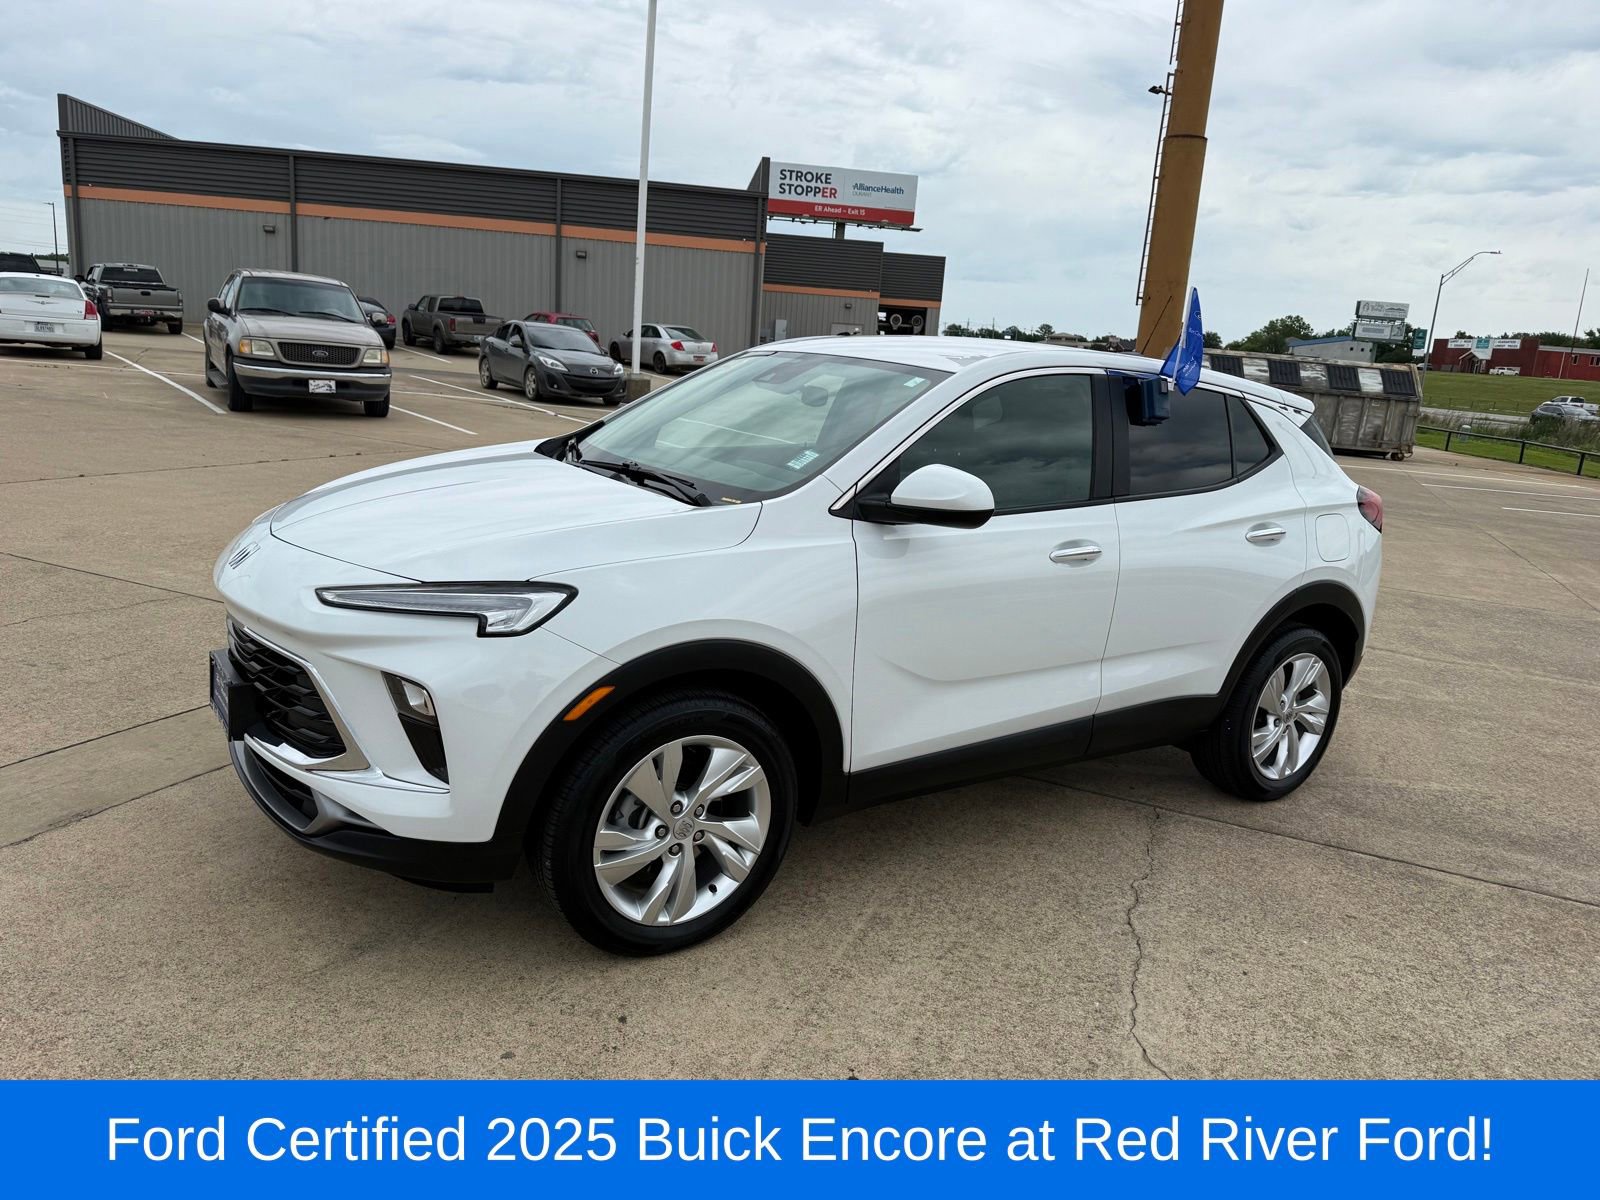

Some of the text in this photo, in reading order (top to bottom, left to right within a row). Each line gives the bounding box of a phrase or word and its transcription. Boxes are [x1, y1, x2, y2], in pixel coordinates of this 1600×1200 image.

[779, 169, 832, 185] STROKE
[778, 183, 838, 199] STOPPER
[853, 183, 904, 195] AllianceHealth
[823, 206, 842, 214] Ahead
